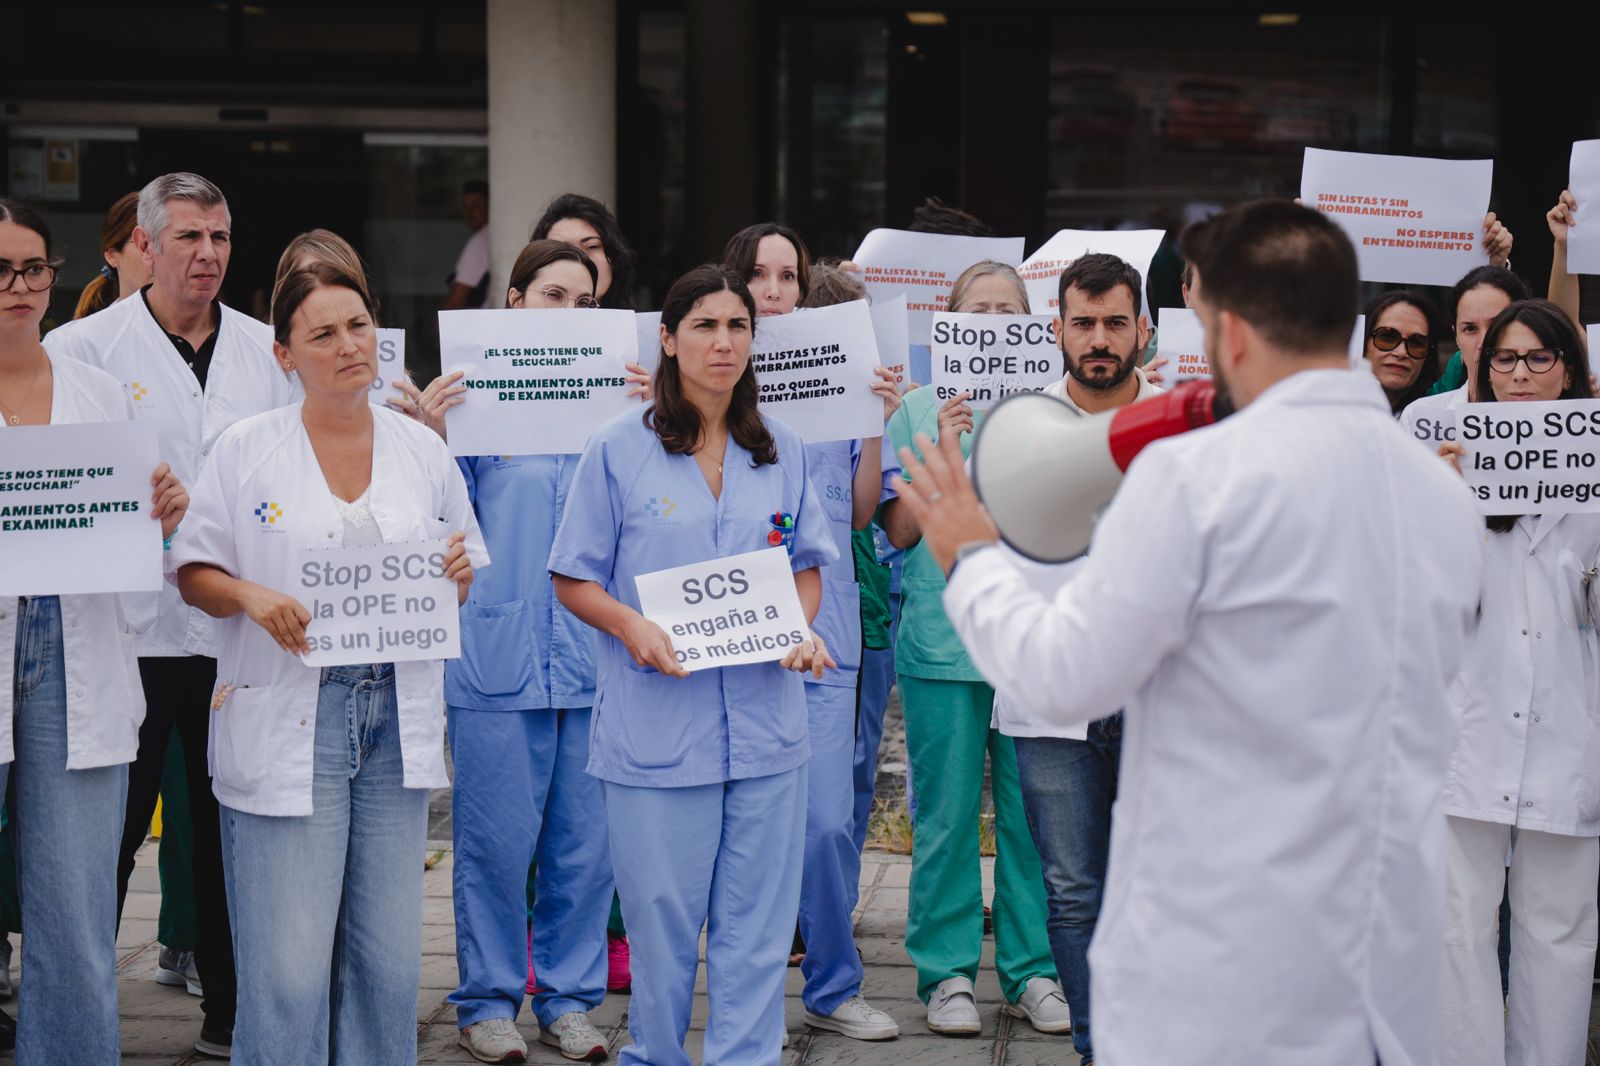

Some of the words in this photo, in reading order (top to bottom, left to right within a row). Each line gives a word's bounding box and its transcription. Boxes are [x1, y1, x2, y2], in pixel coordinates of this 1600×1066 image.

[1318, 193, 1337, 202] SIN
[1339, 195, 1378, 206] LISTAS
[1380, 198, 1388, 206] Y
[1389, 198, 1409, 208] SIN
[1317, 203, 1423, 219] NOMBRAMIENTOS
[1396, 228, 1416, 237] NO
[1419, 230, 1474, 241] ESPERES
[1362, 237, 1473, 251] ENTENDIMIENTO
[884, 268, 918, 276] LISTAS
[928, 271, 946, 279] SIN
[934, 321, 997, 352] Stop
[484, 348, 501, 359] ¡EL
[502, 348, 522, 357] SCS
[523, 348, 546, 356] NOS
[547, 347, 579, 356] TIENE
[580, 346, 603, 357] QUE
[752, 353, 766, 362] IN
[768, 348, 809, 361] LISTAS
[811, 347, 819, 356] Y
[820, 343, 840, 355] SIN
[1178, 354, 1199, 364] SIN
[944, 354, 962, 374] la
[968, 356, 1018, 375] OPE
[1024, 359, 1050, 374] no
[1178, 365, 1209, 375] NOM
[461, 378, 584, 389] NOMBRAMIENTOS
[585, 377, 626, 387] ANTES
[788, 378, 829, 390] QUEDA
[498, 391, 516, 401] DE
[517, 389, 590, 401] EXAMINAR!
[936, 386, 957, 400] es
[1462, 414, 1534, 445] Stop
[1474, 451, 1496, 470] la
[1504, 449, 1558, 471] OPE
[1566, 452, 1596, 468] no
[0, 471, 12, 480] CS
[15, 470, 44, 480] NOS
[46, 468, 84, 478] TIENE
[87, 467, 114, 478] QUE
[1499, 484, 1529, 499] un
[0, 502, 86, 517] AMIENTOS
[88, 501, 139, 513] ANTES
[2, 516, 94, 532] EXAMINAR!
[301, 561, 372, 590] Stop
[381, 552, 446, 581] SCS
[681, 568, 750, 605] SCS
[313, 599, 334, 619] la
[342, 593, 397, 617] OPE
[405, 596, 436, 613] no
[671, 608, 758, 637] engaña
[764, 604, 779, 620] a
[306, 635, 333, 651] es
[341, 632, 370, 649] un
[376, 626, 448, 652] juego
[677, 646, 701, 663] os
[706, 629, 804, 658] médicos
